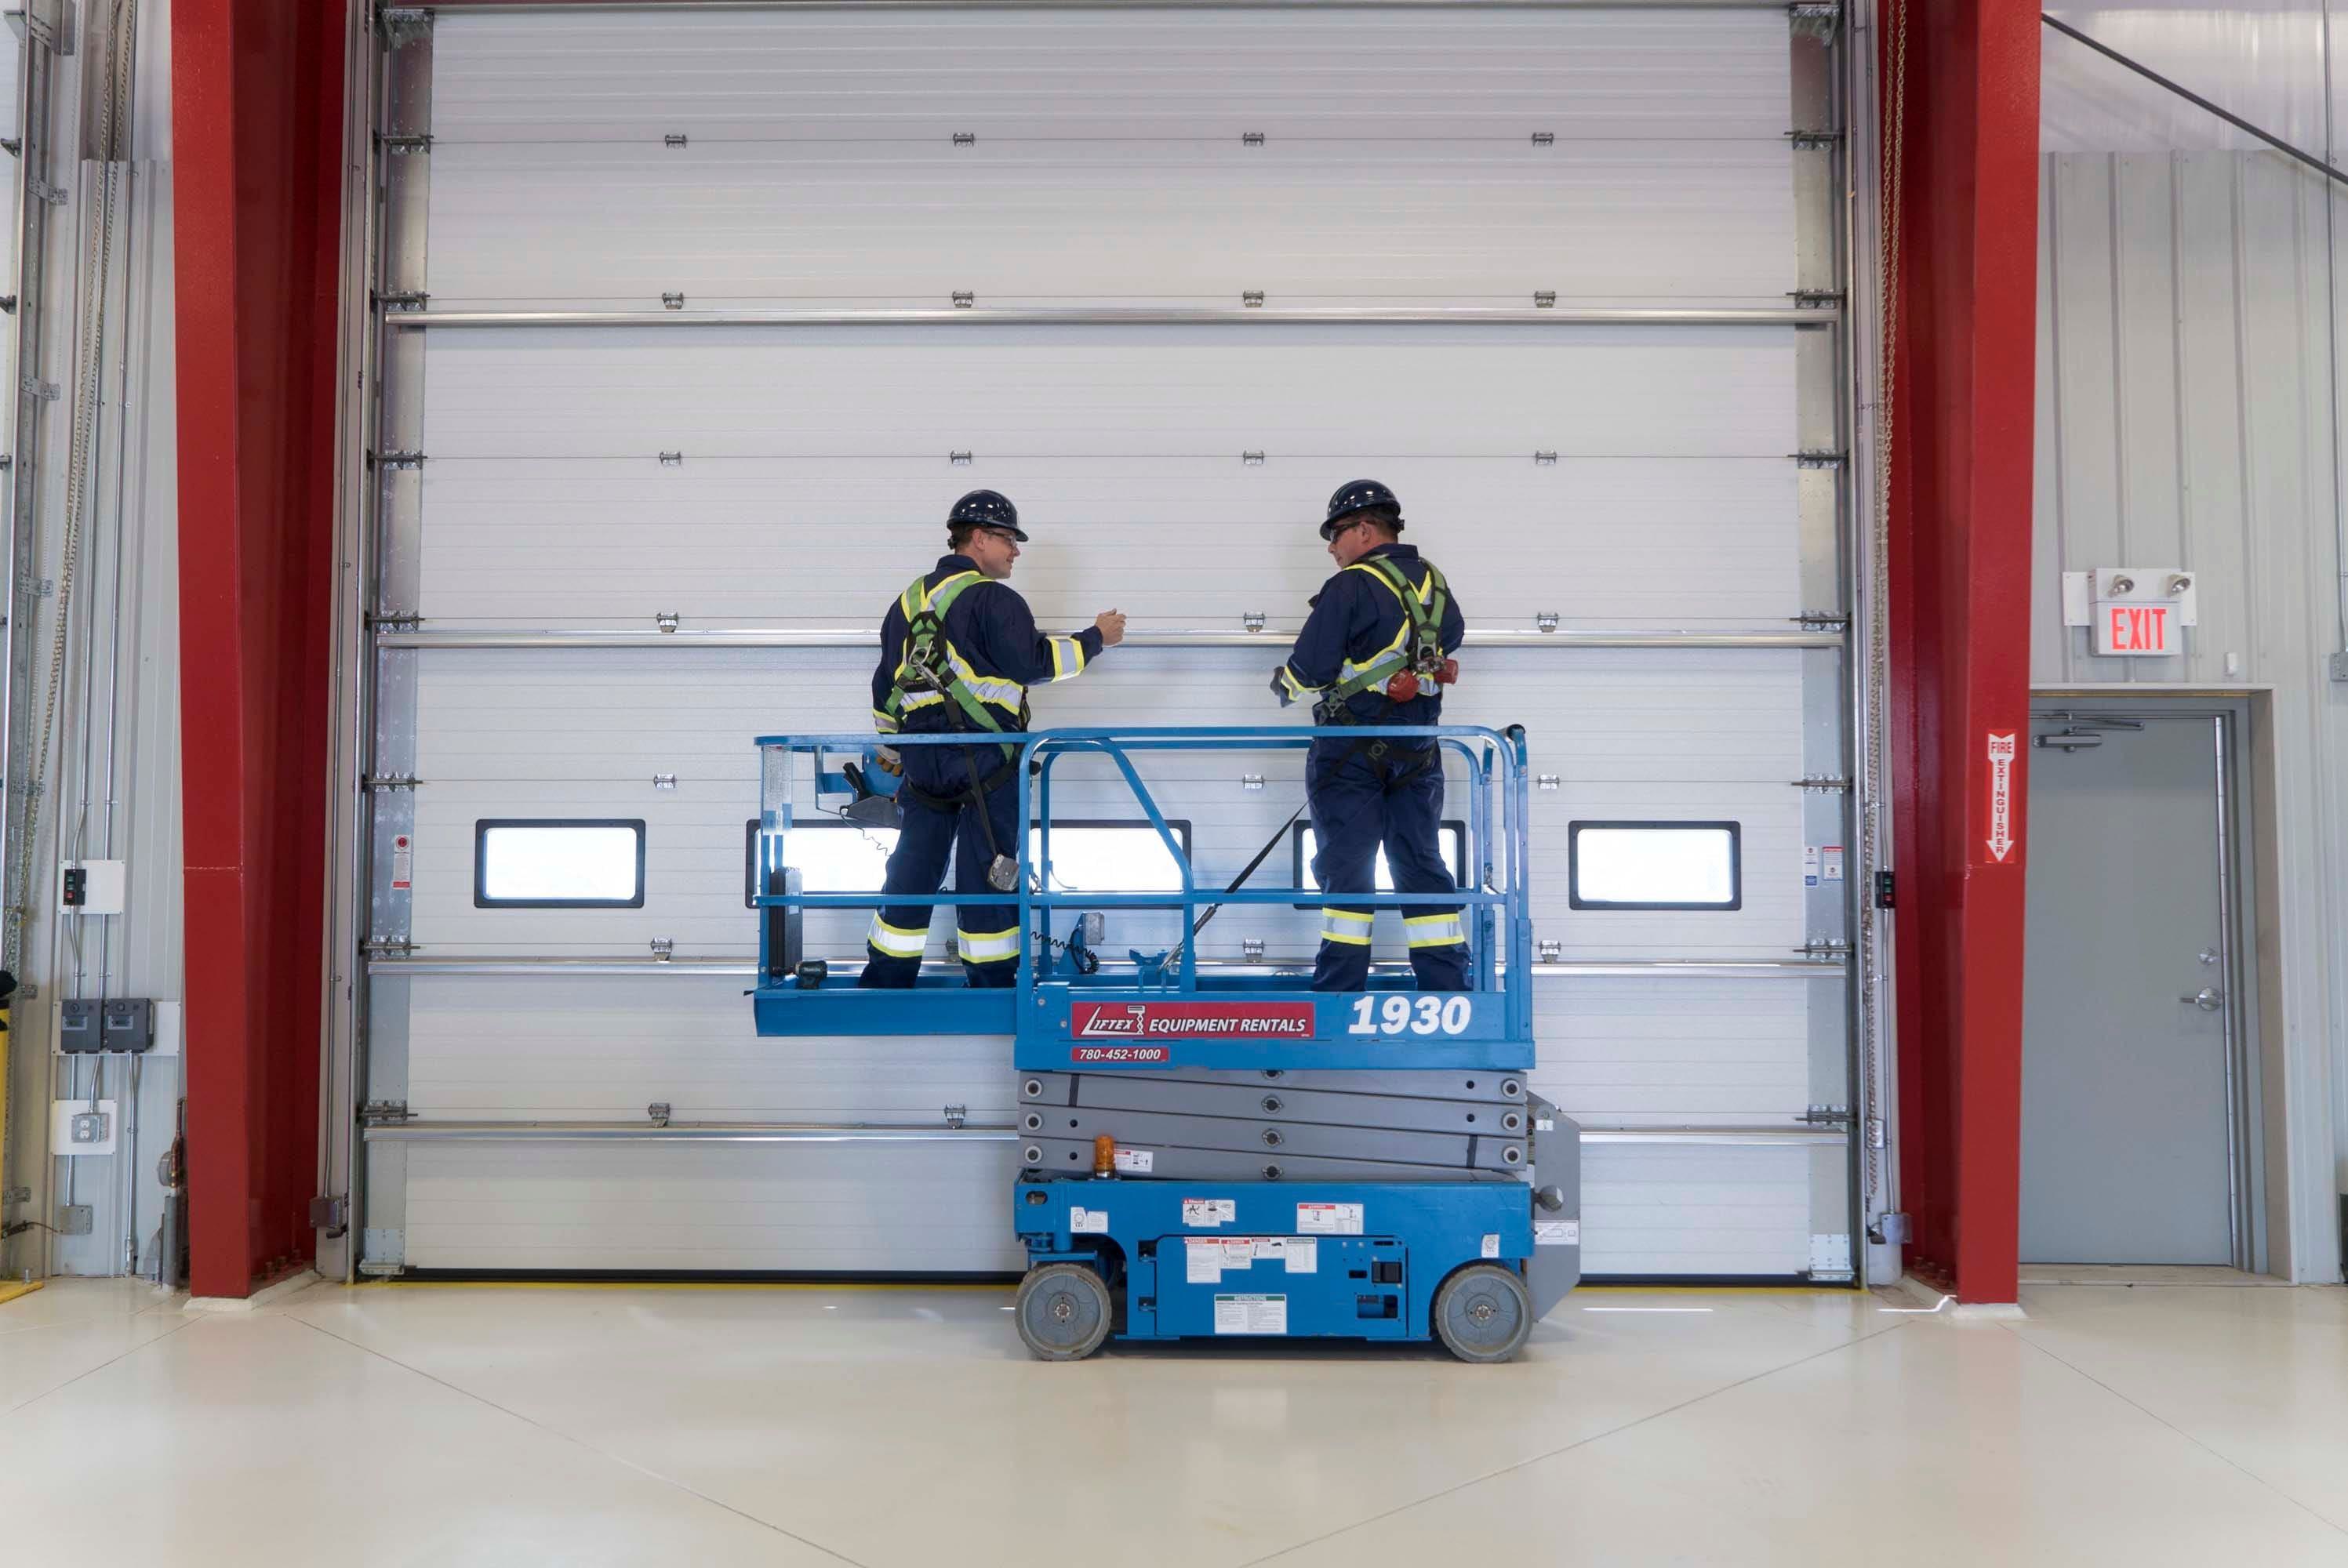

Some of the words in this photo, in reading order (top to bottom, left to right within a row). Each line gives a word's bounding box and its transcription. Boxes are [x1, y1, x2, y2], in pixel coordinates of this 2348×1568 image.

[2110, 608, 2167, 650] EXIT
[1990, 741, 2012, 754] FIRE
[1996, 759, 2005, 854] EXTINGUISHER
[1081, 1005, 1139, 1036] LIFTEX
[1149, 1018, 1238, 1033] EQUIPMENT
[1240, 1018, 1307, 1033] RENTALS
[1348, 996, 1471, 1035] 1930
[1079, 1049, 1161, 1060] 780-452-1000
